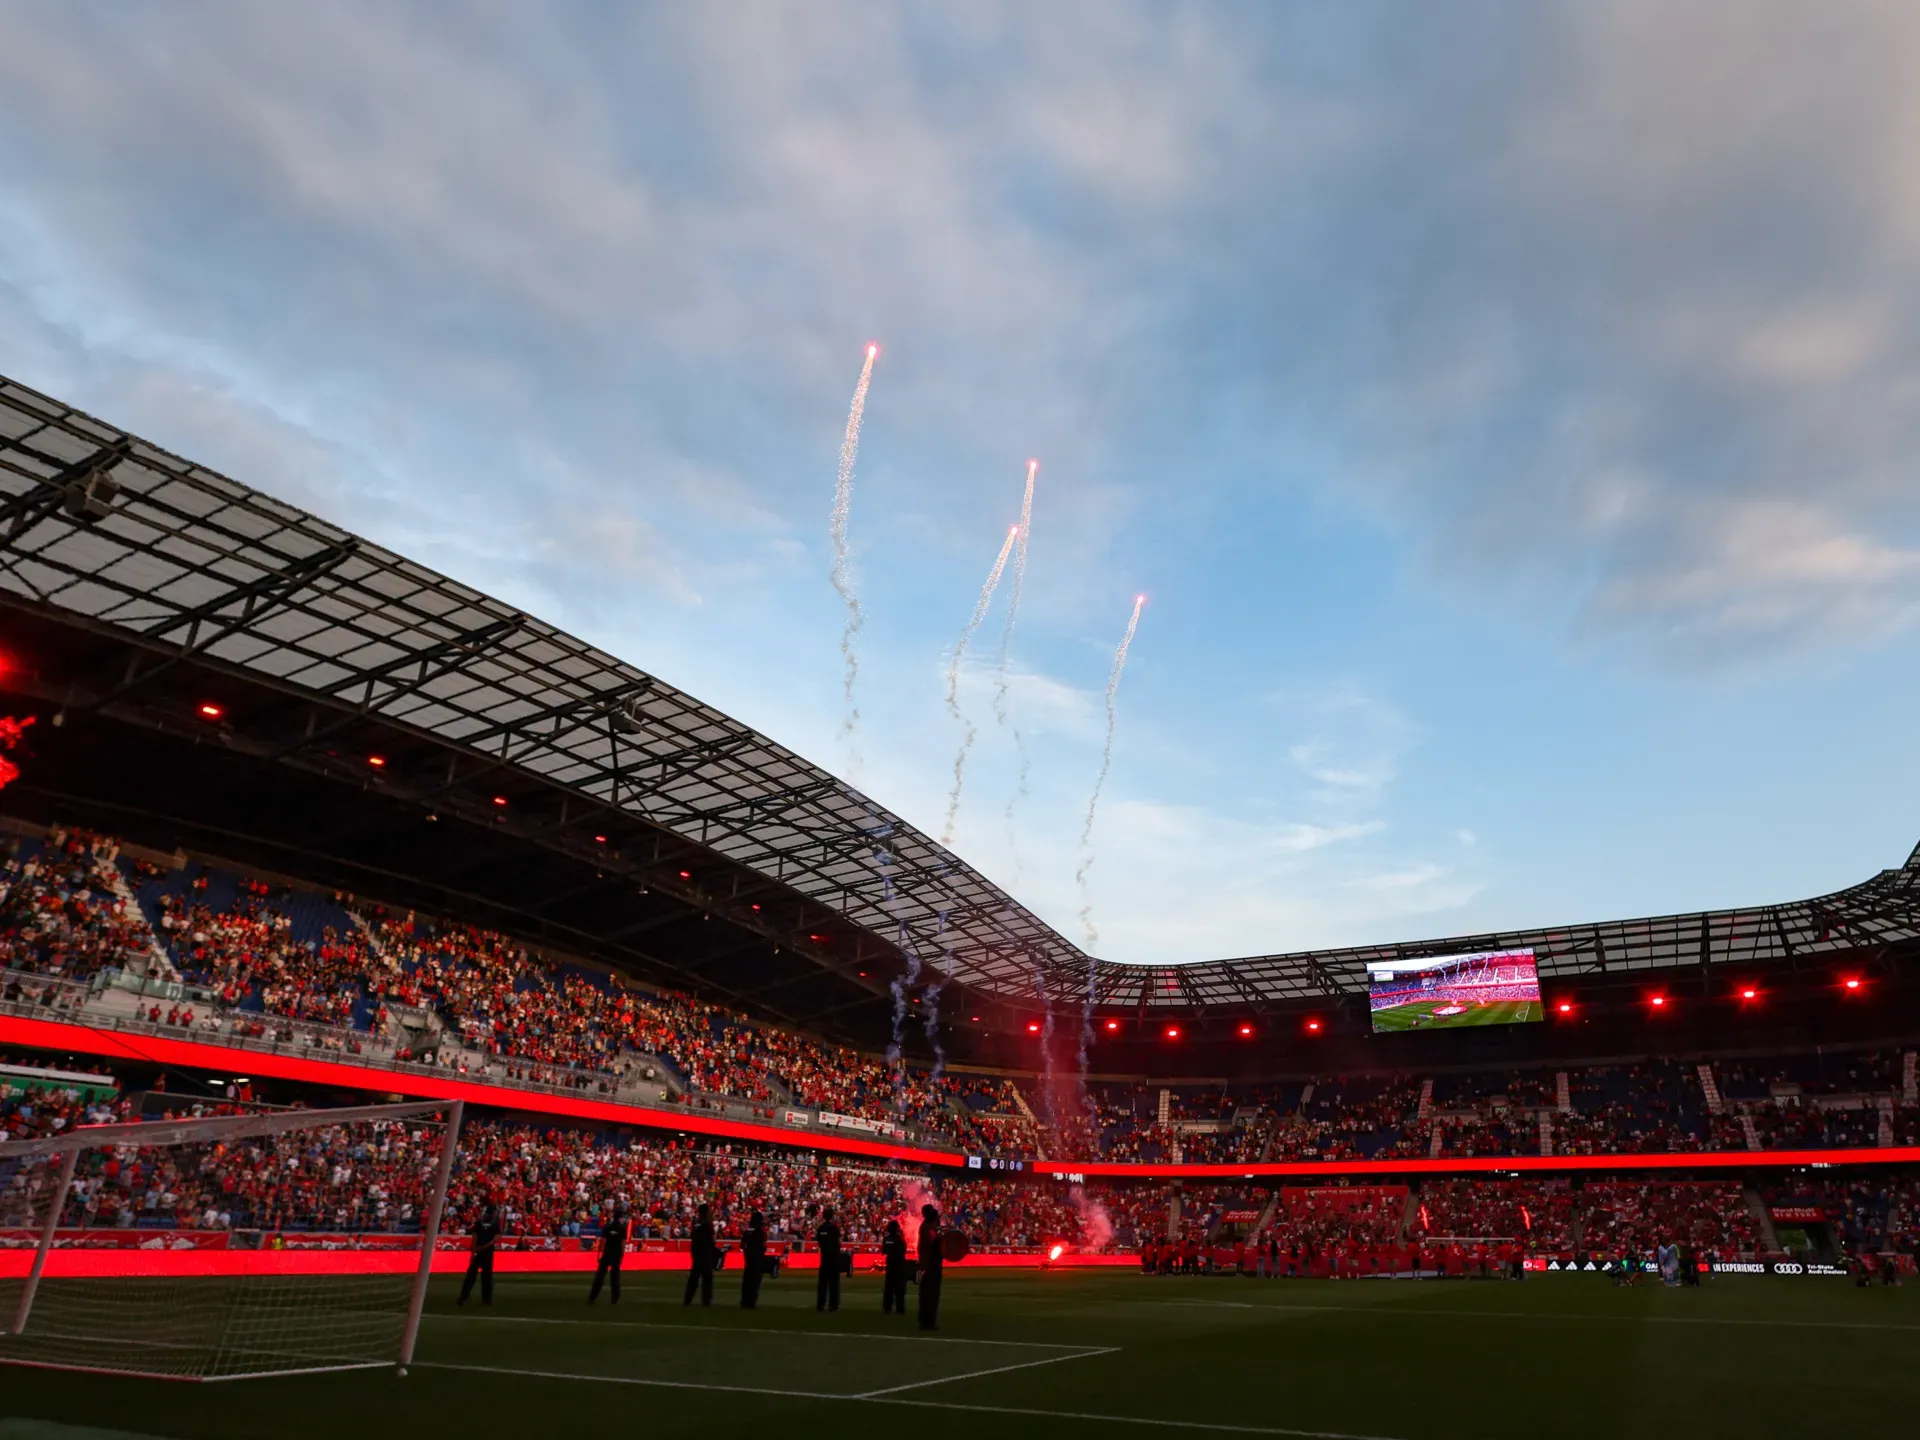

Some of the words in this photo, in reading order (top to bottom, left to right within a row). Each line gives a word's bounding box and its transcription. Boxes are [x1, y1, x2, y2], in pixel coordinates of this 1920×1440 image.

[999, 1159, 1005, 1170] 0
[1009, 1160, 1015, 1171] 0
[1722, 1263, 1765, 1273] EXPERIENCES
